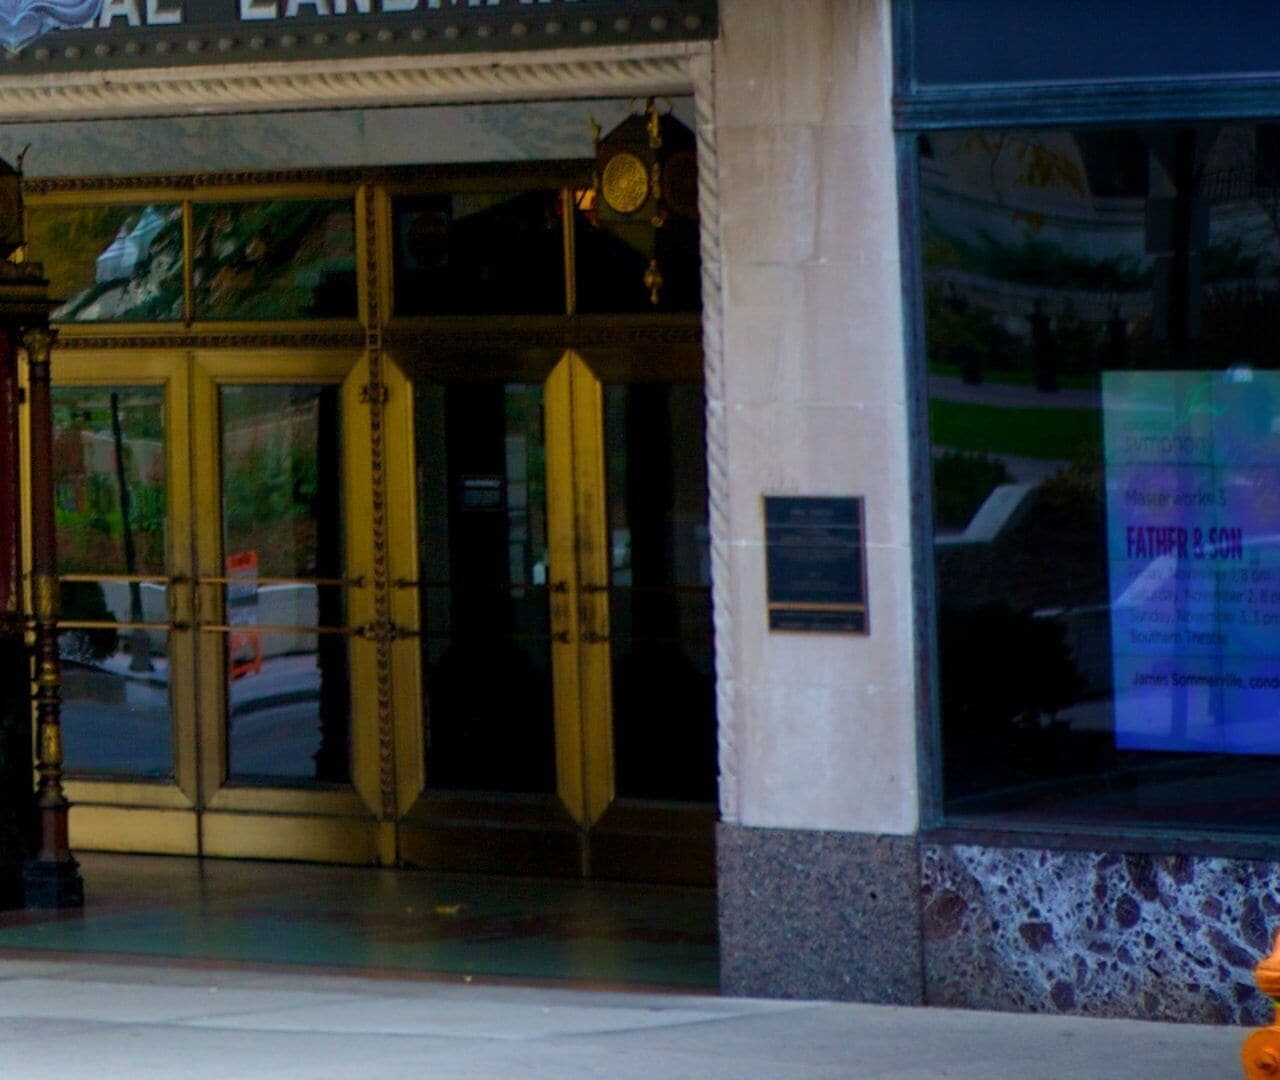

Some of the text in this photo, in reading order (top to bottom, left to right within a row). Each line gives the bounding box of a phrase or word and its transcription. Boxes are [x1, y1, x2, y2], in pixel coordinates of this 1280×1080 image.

[1126, 526, 1243, 561] FATHER & SON
